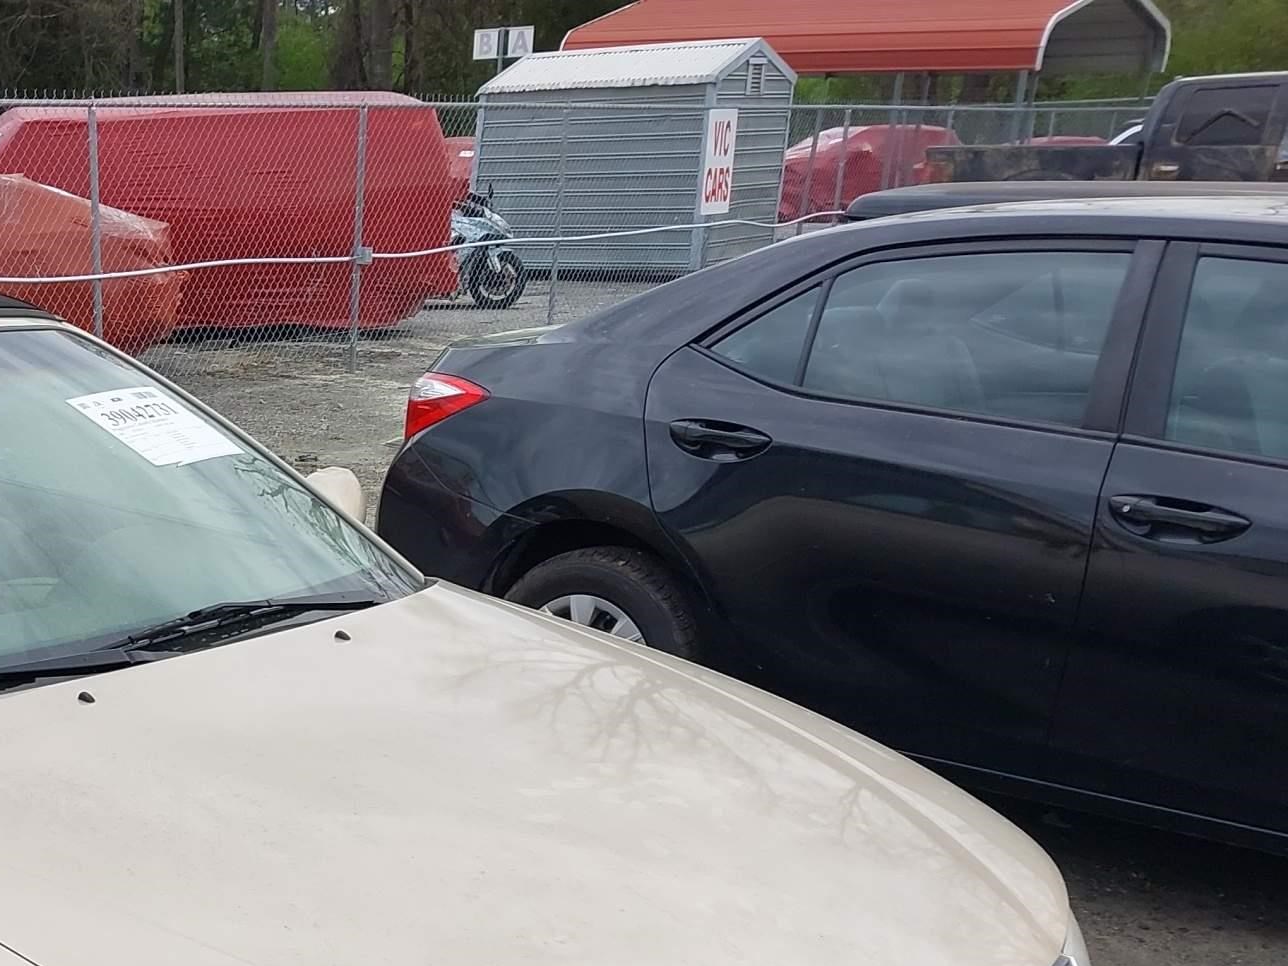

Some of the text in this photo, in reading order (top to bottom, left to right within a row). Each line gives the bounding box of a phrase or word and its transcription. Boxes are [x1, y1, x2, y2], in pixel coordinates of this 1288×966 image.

[479, 32, 493, 56] B
[511, 30, 530, 54] A
[713, 119, 732, 157] VIC
[704, 166, 731, 203] CARS
[100, 401, 179, 427] 39042731
